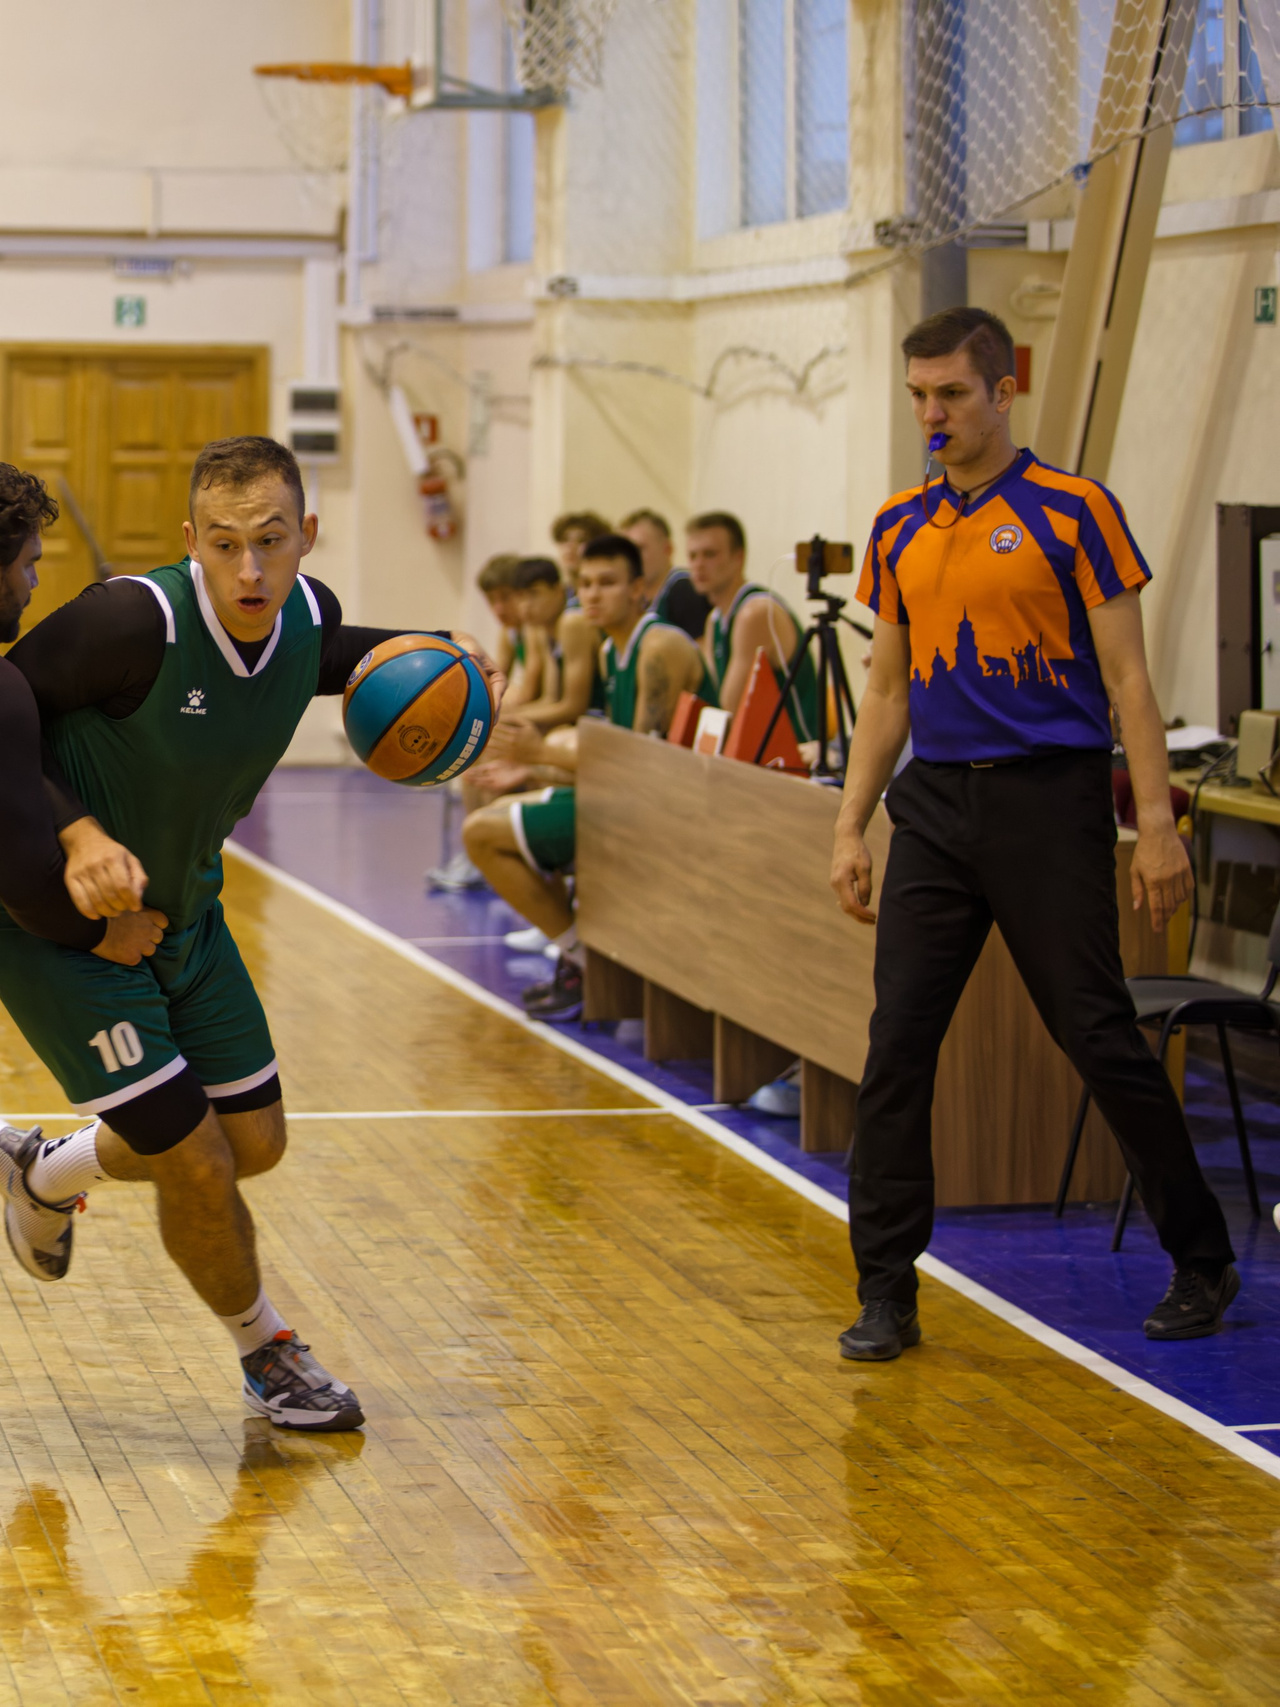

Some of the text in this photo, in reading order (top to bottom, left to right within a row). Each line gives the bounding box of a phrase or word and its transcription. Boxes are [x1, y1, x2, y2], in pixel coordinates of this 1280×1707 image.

[180, 706, 207, 715] KELME
[435, 718, 484, 781] SIBUR
[88, 1020, 145, 1074] 10
